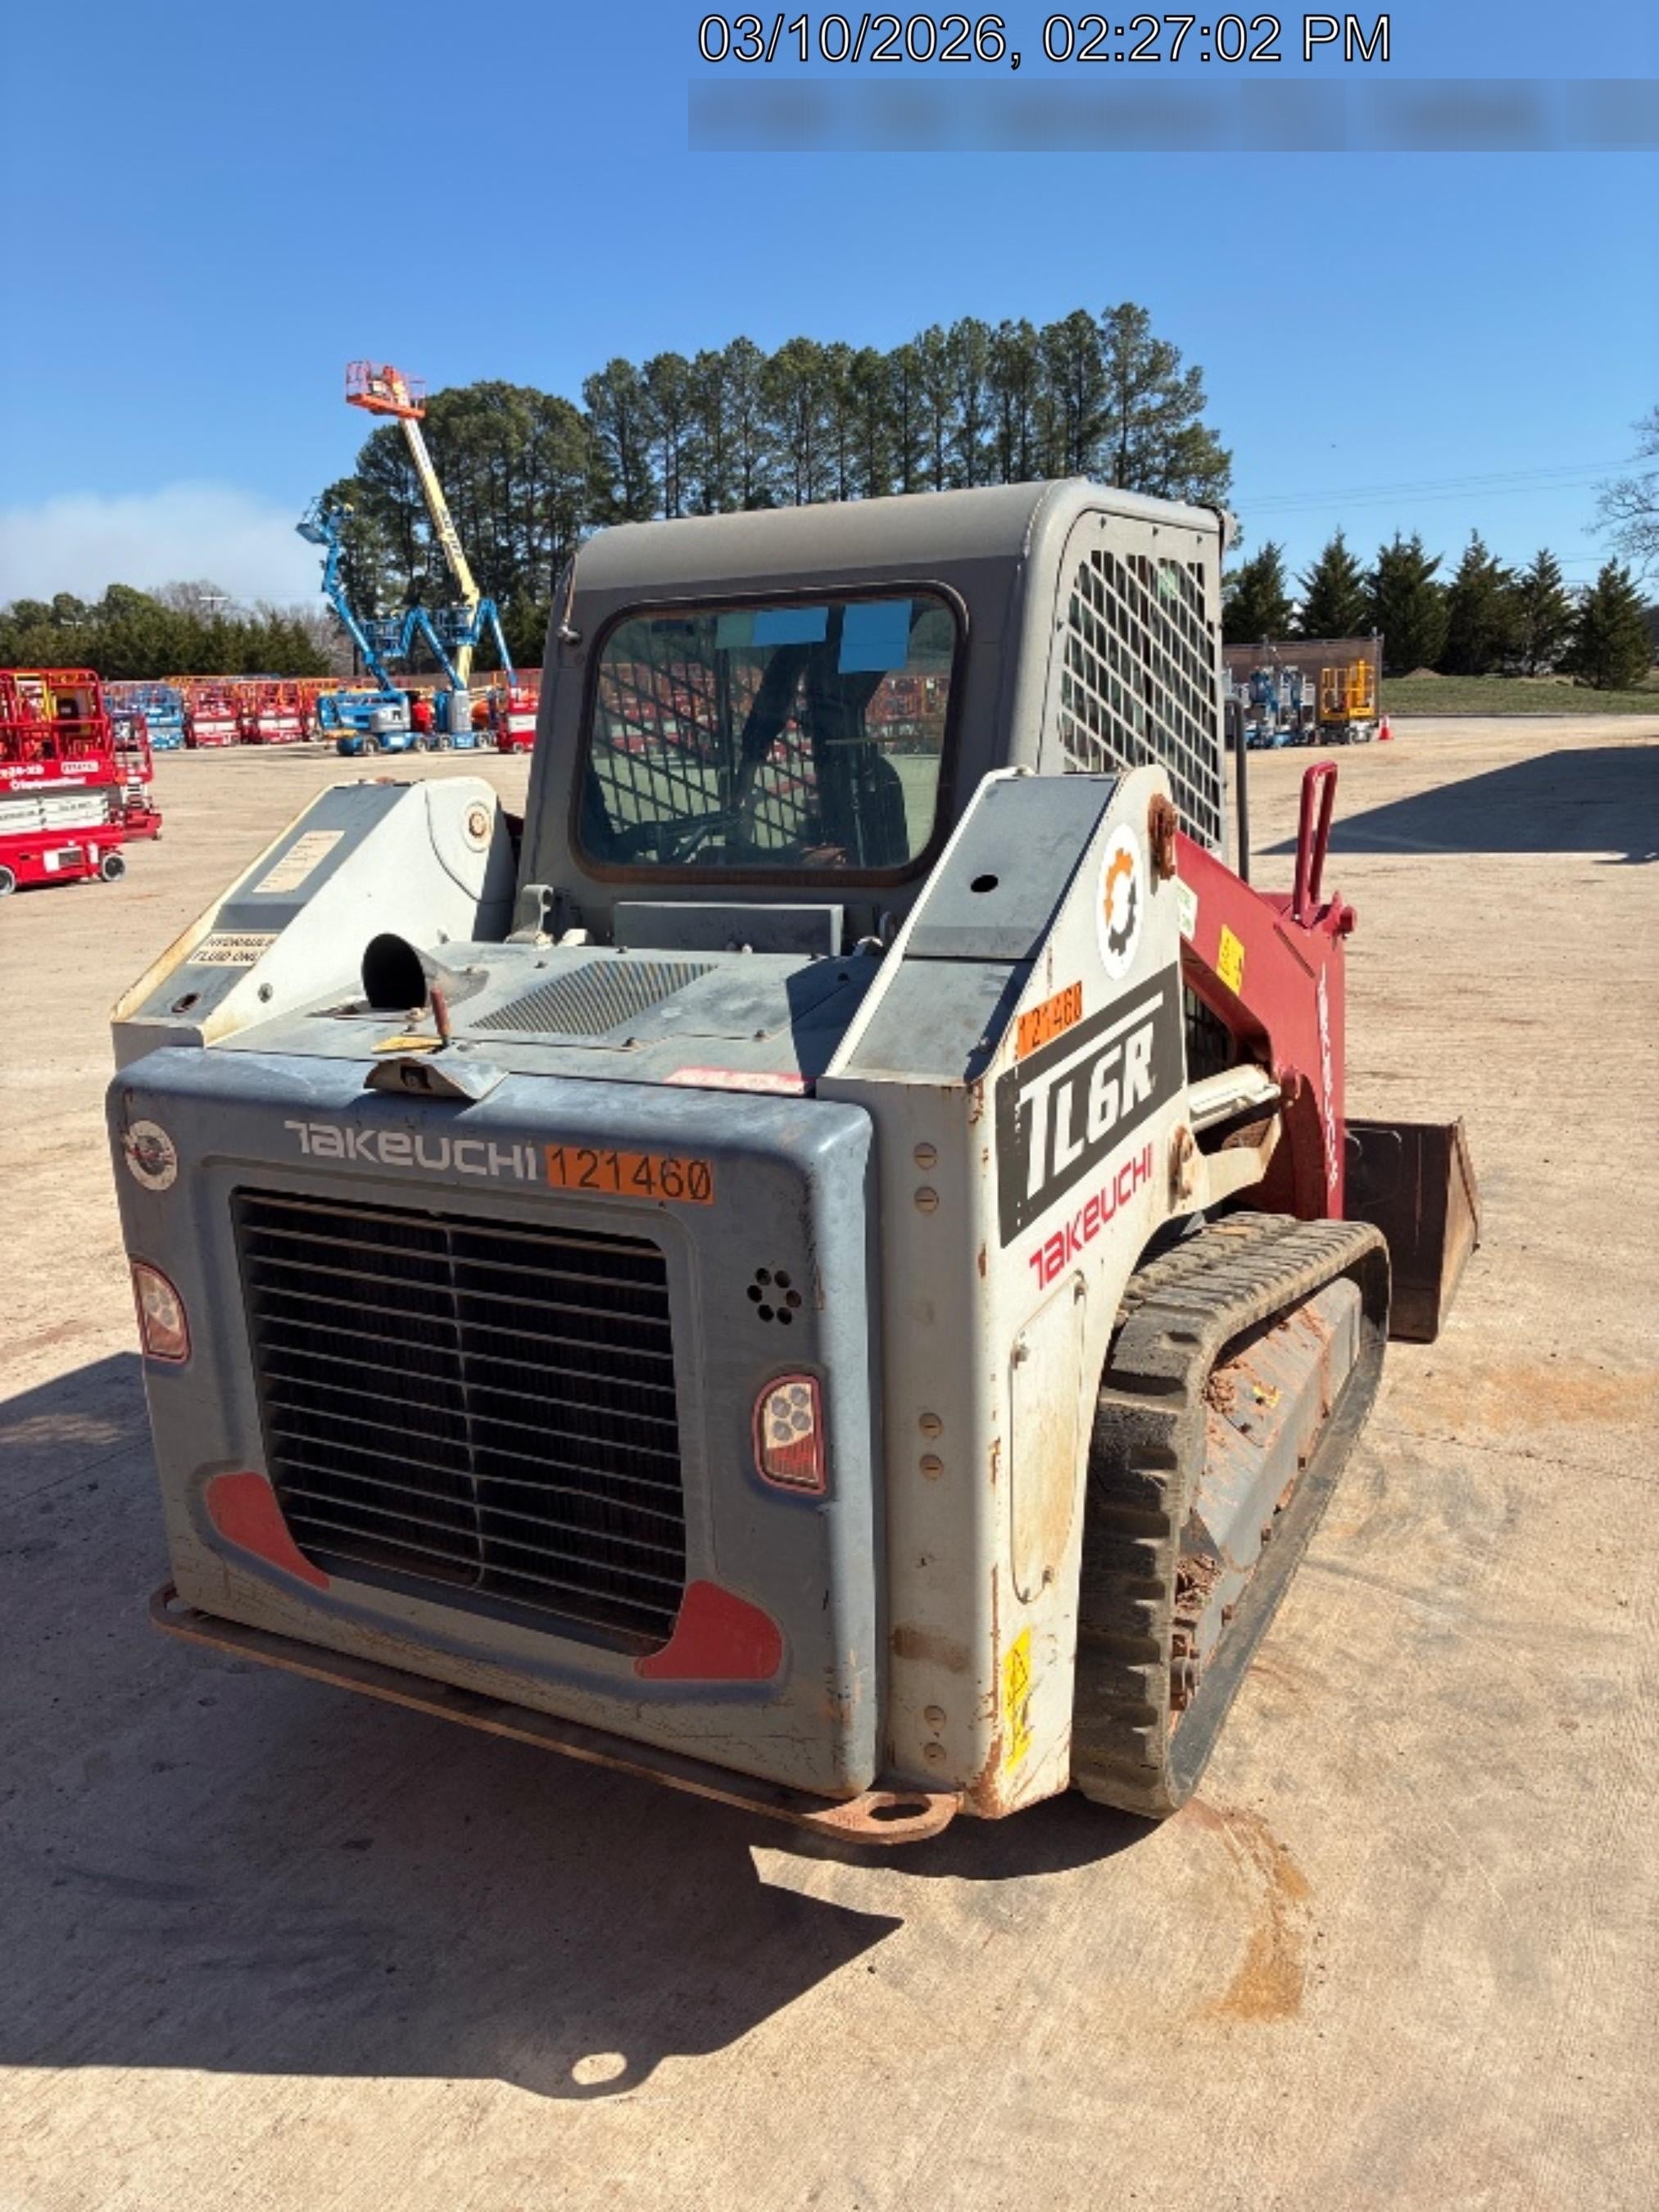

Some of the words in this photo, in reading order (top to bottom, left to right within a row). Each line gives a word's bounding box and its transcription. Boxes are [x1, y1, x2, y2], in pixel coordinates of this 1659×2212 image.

[1018, 981, 1082, 1054] 121460
[1019, 991, 1163, 1200] TL6R
[550, 1148, 712, 1200] 121460
